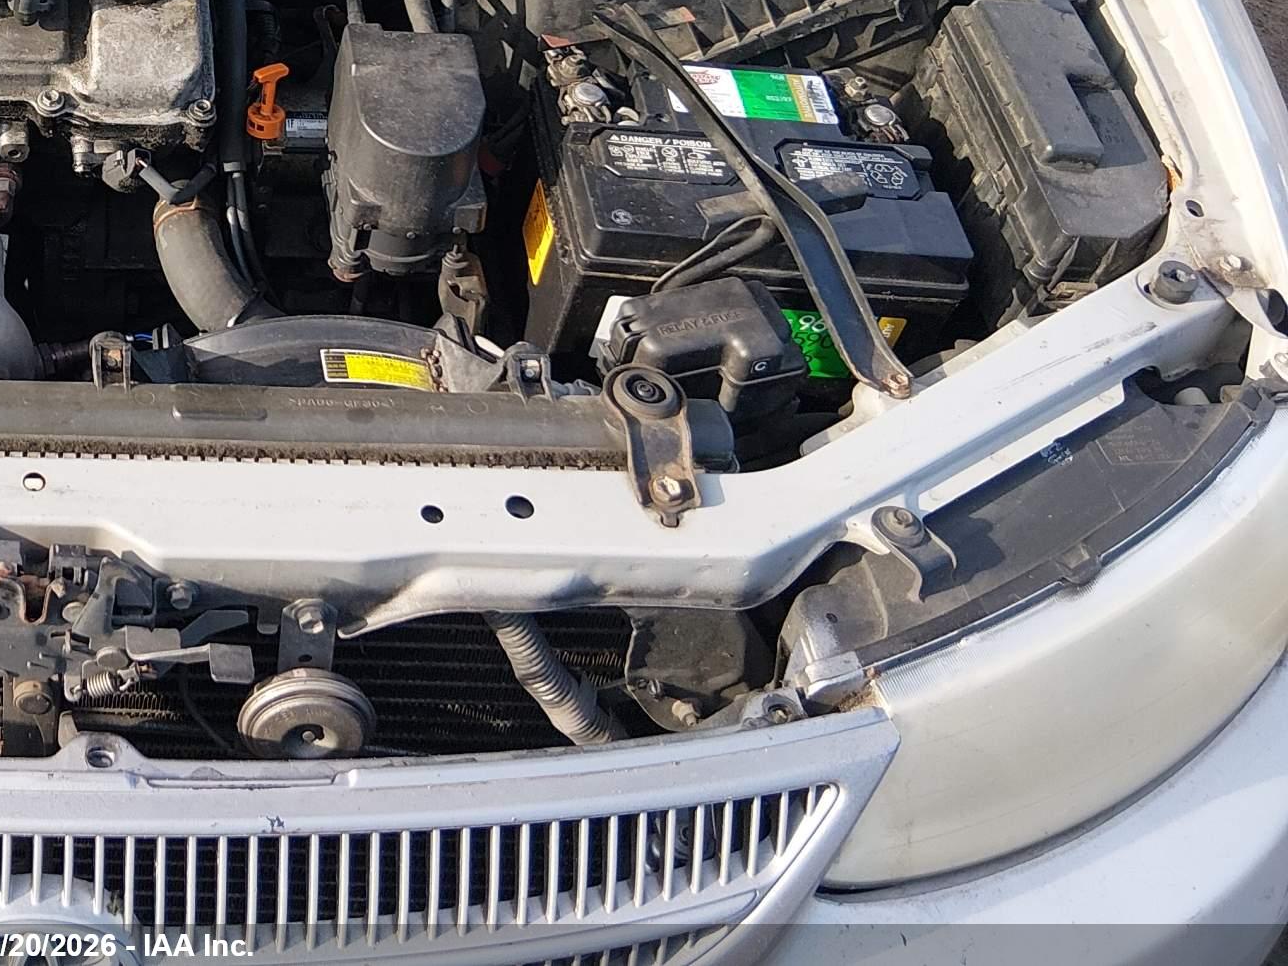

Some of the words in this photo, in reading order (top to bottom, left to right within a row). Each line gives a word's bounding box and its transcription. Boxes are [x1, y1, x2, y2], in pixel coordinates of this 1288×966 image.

[621, 135, 663, 145] DANGER
[673, 139, 712, 148] POISON
[658, 319, 698, 336] RELAY
